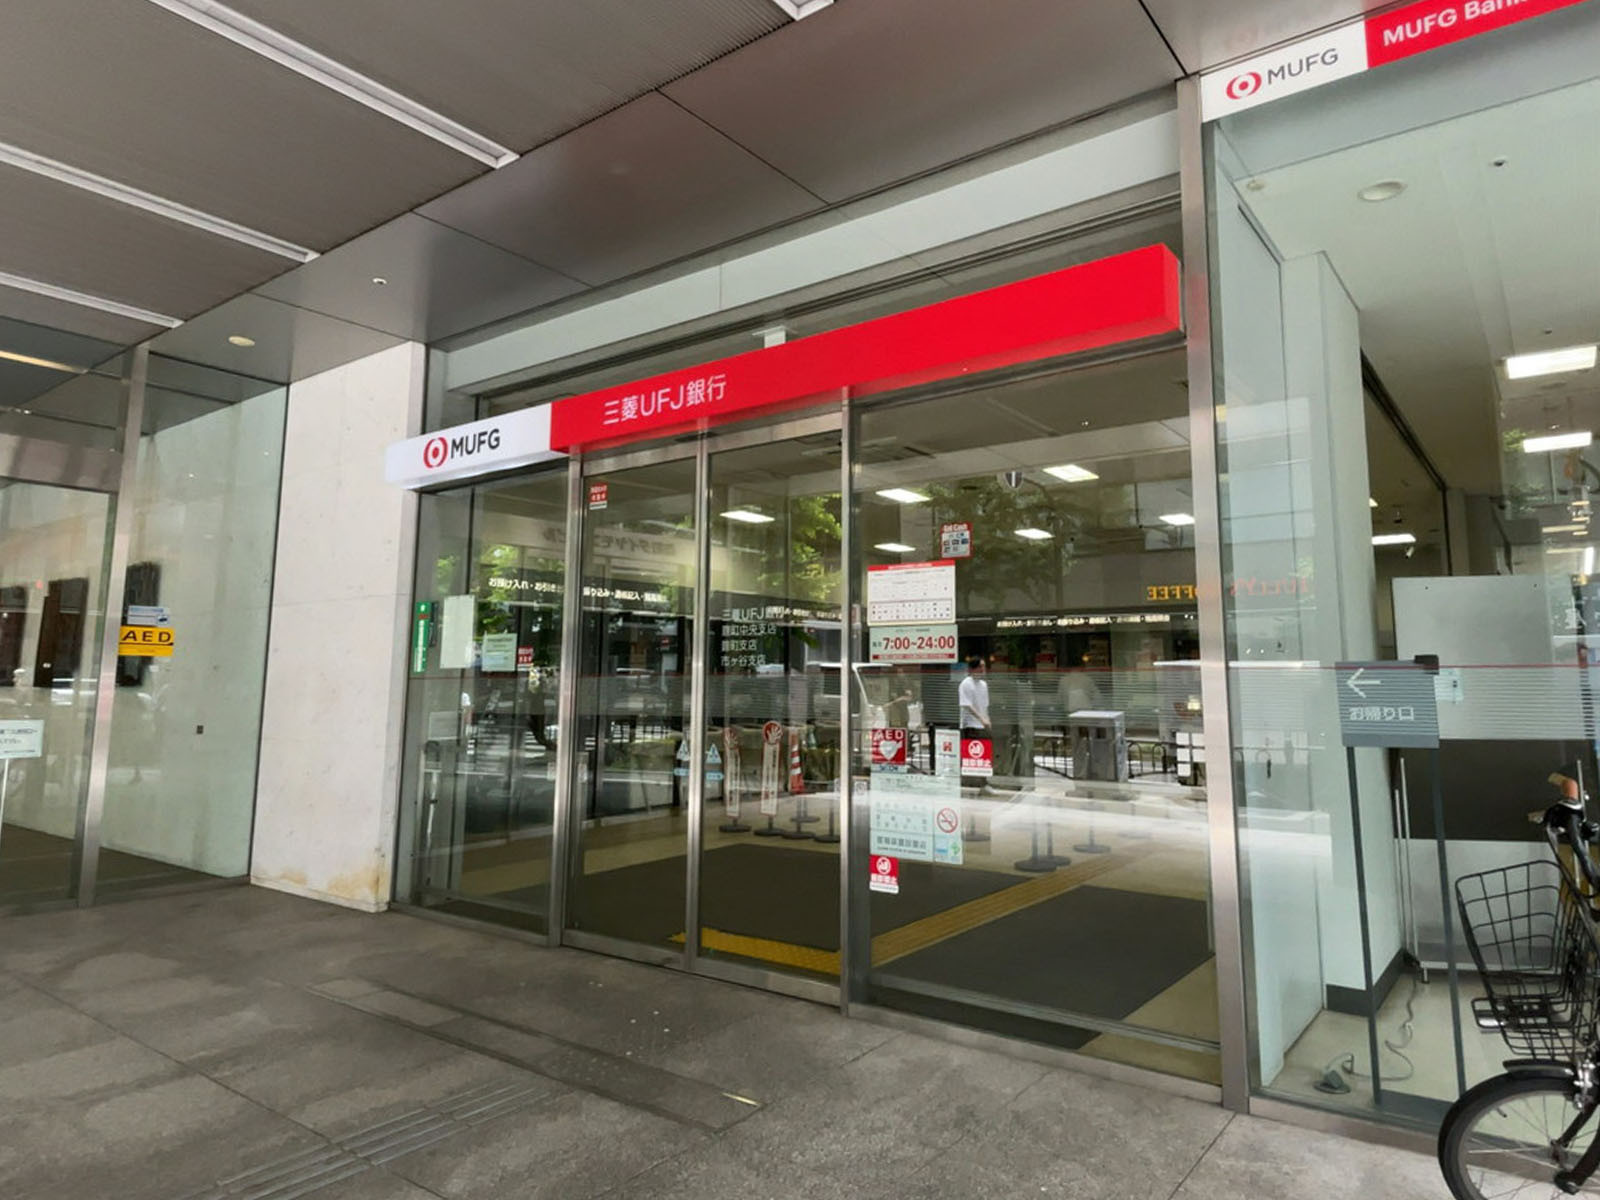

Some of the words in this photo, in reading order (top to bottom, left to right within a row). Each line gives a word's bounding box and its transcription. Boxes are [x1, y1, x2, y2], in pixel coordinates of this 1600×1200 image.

[1383, 8, 1458, 47] MUFG
[1463, 0, 1528, 21] Ban
[1267, 48, 1339, 85] MUFG
[603, 373, 728, 426] 三菱UFJ銀行
[450, 429, 501, 460] MUFG
[122, 630, 172, 643] AED
[874, 729, 904, 740] AED
